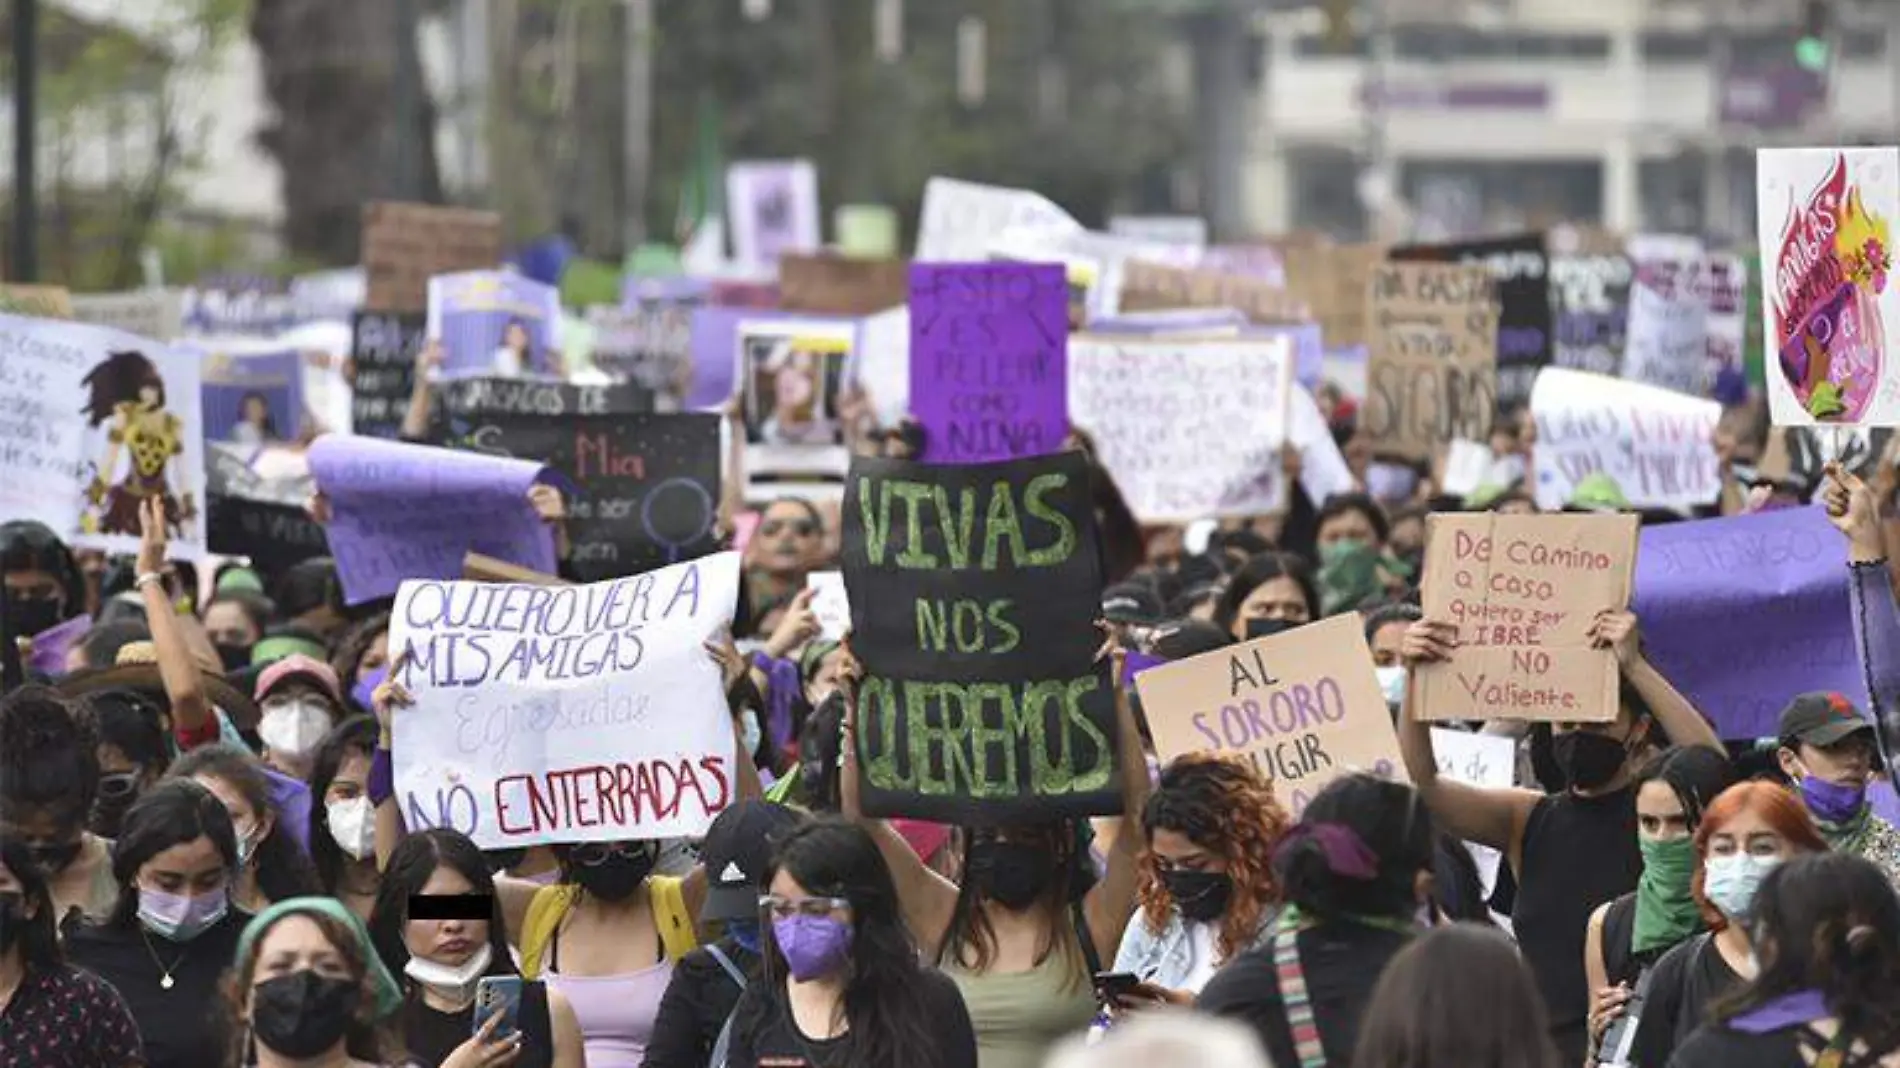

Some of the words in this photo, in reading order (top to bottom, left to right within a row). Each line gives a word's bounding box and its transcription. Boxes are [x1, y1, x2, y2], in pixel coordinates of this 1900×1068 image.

[932, 268, 1037, 307] ESTO
[950, 313, 998, 346] ES
[859, 473, 1076, 571] VIVAS
[1455, 528, 1492, 562] De
[405, 582, 578, 636] QUIERO
[583, 574, 655, 632] VER
[662, 563, 700, 617] A
[1450, 599, 1524, 623] quiero
[1532, 610, 1568, 626] ser
[915, 599, 1020, 653] NOS
[1455, 624, 1542, 647] LIBRE
[402, 632, 492, 689] MIS
[494, 625, 645, 681] AMIGAS
[1229, 648, 1280, 697] AL
[1512, 650, 1550, 675] NO
[858, 674, 1111, 798] QUEREMOS
[1192, 676, 1345, 750] SORORO
[1250, 733, 1332, 781] UGIR
[407, 783, 478, 836] NO
[495, 756, 728, 835] ENTERRADAS
